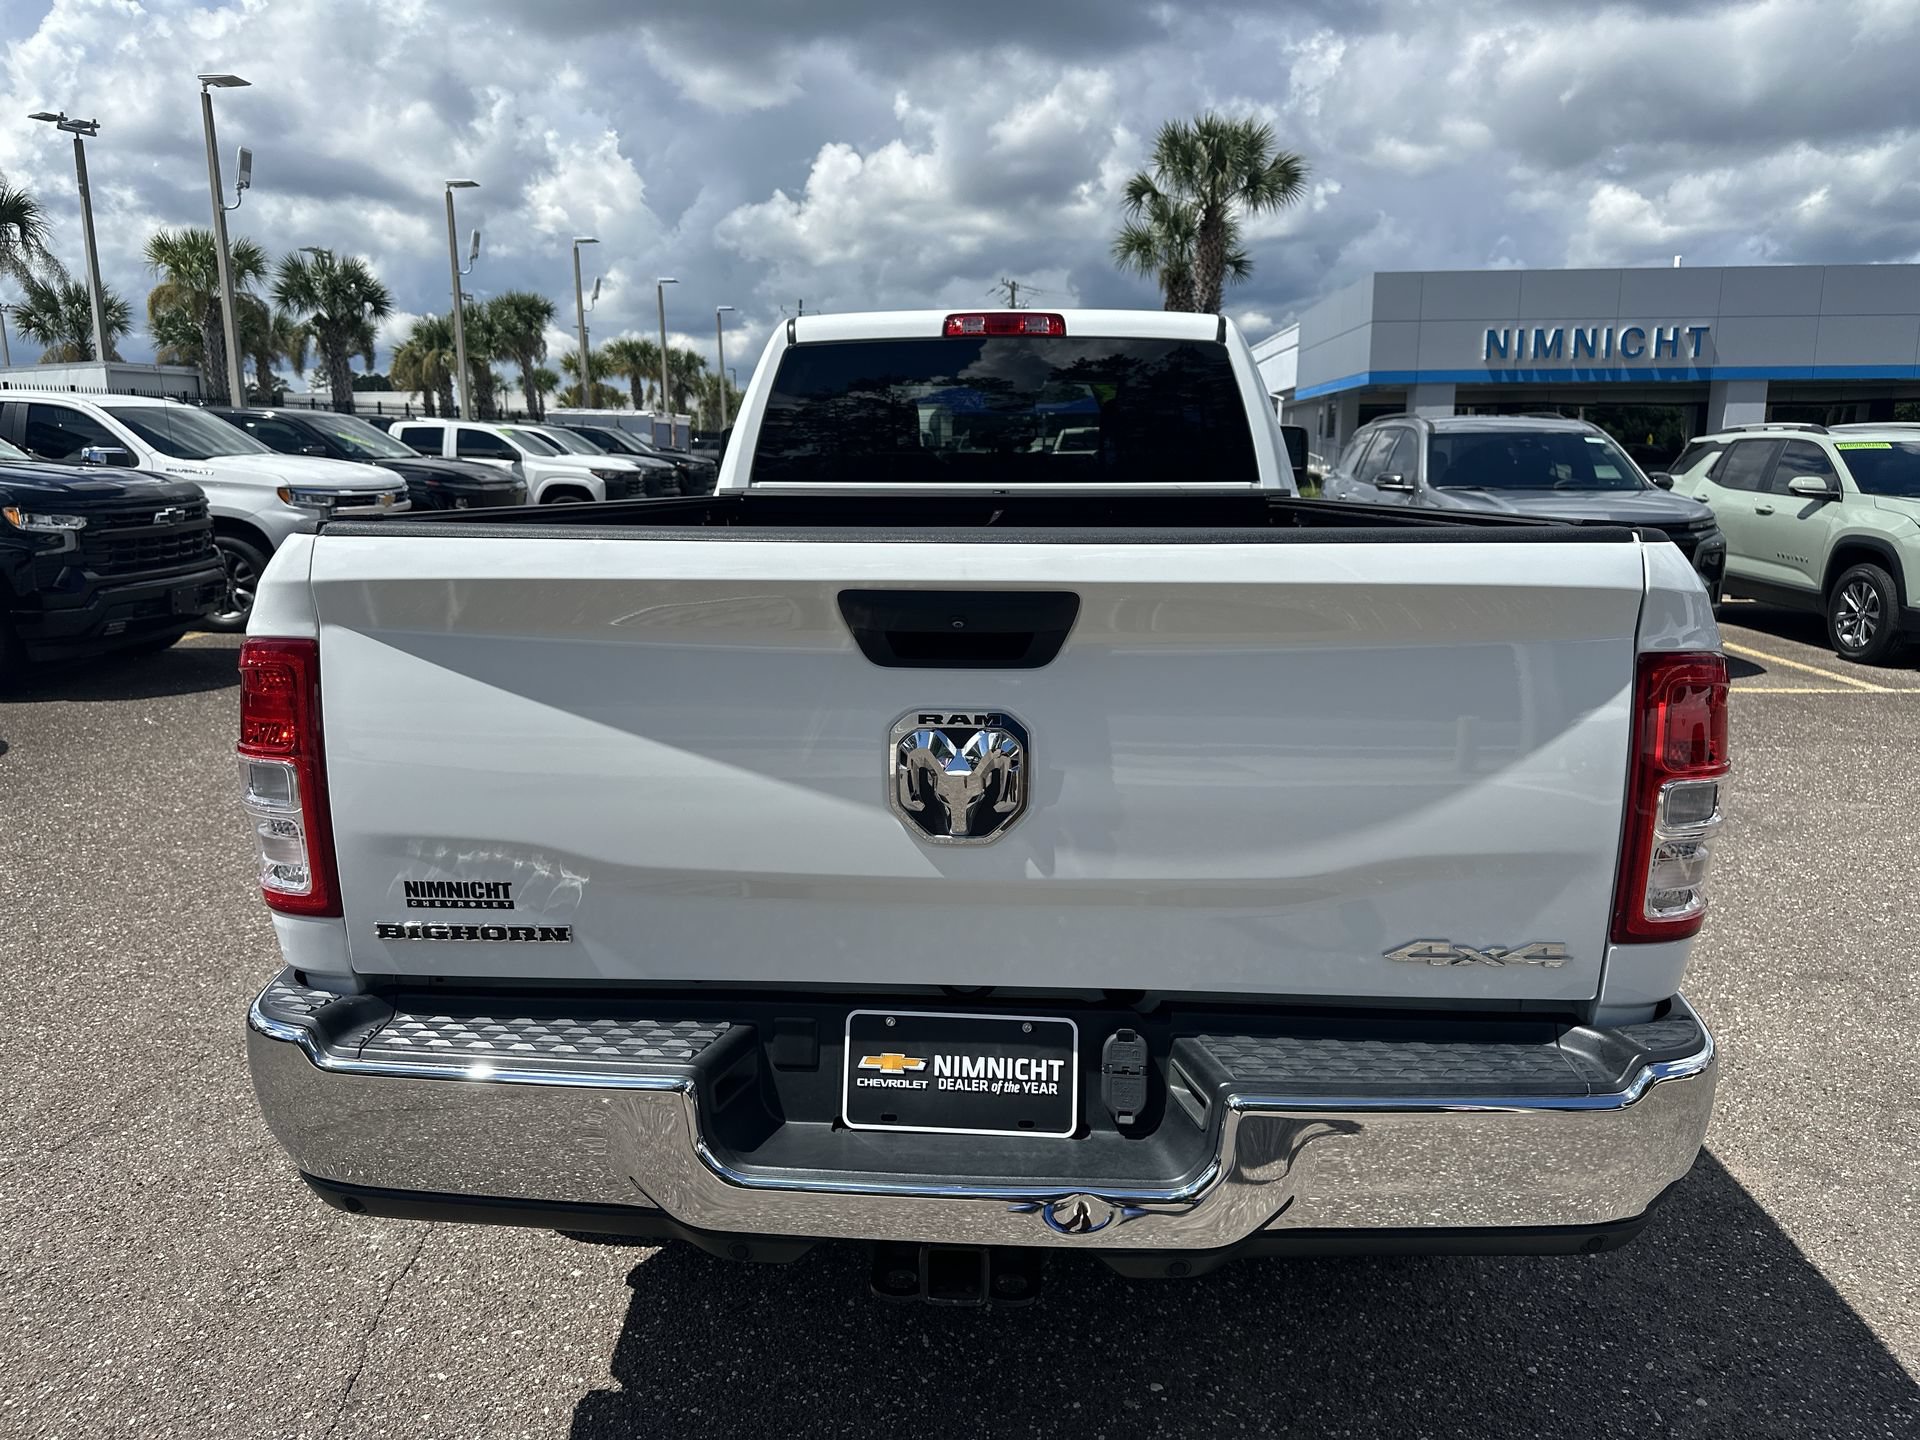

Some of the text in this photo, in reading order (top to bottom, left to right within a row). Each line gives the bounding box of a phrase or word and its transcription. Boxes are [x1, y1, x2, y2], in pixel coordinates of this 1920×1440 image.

[1483, 325, 1711, 361] NIMNICHT
[918, 714, 1003, 728] RAM
[404, 881, 513, 900] NIMNICHT
[410, 900, 511, 908] CHEVROLET
[375, 921, 573, 943] BIGHORN
[934, 1054, 1065, 1082] NIMNICHT
[856, 1077, 929, 1090] CHEVROLET
[938, 1078, 1058, 1095] DEALER of the YEAR
